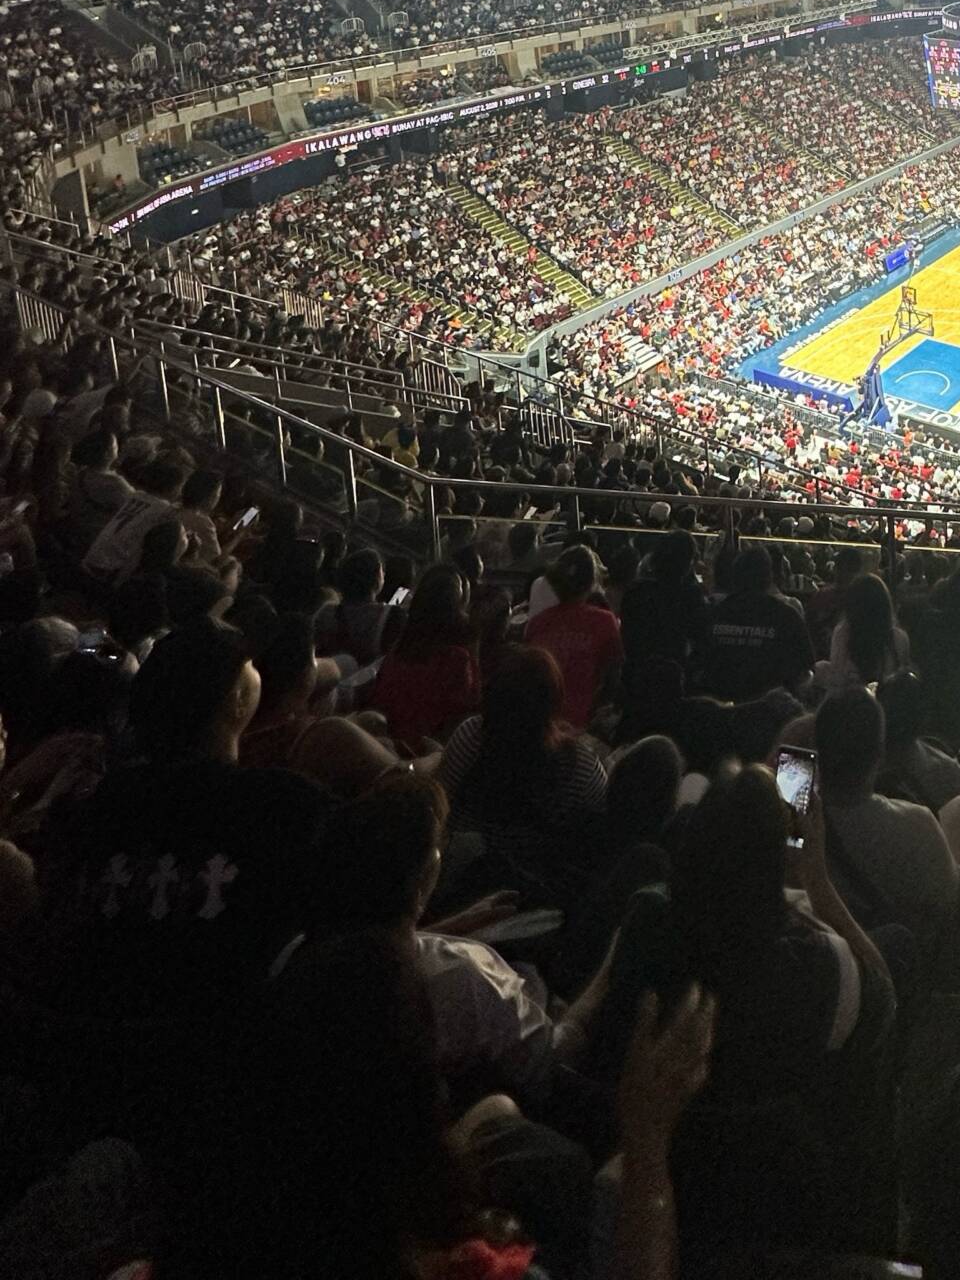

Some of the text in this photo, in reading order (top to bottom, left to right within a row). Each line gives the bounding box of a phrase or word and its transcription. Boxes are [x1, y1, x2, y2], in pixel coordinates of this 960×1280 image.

[305, 131, 372, 154] IKALAWANG
[392, 122, 415, 133] BUHAY
[416, 120, 425, 128] AT
[778, 366, 858, 397] ARENA
